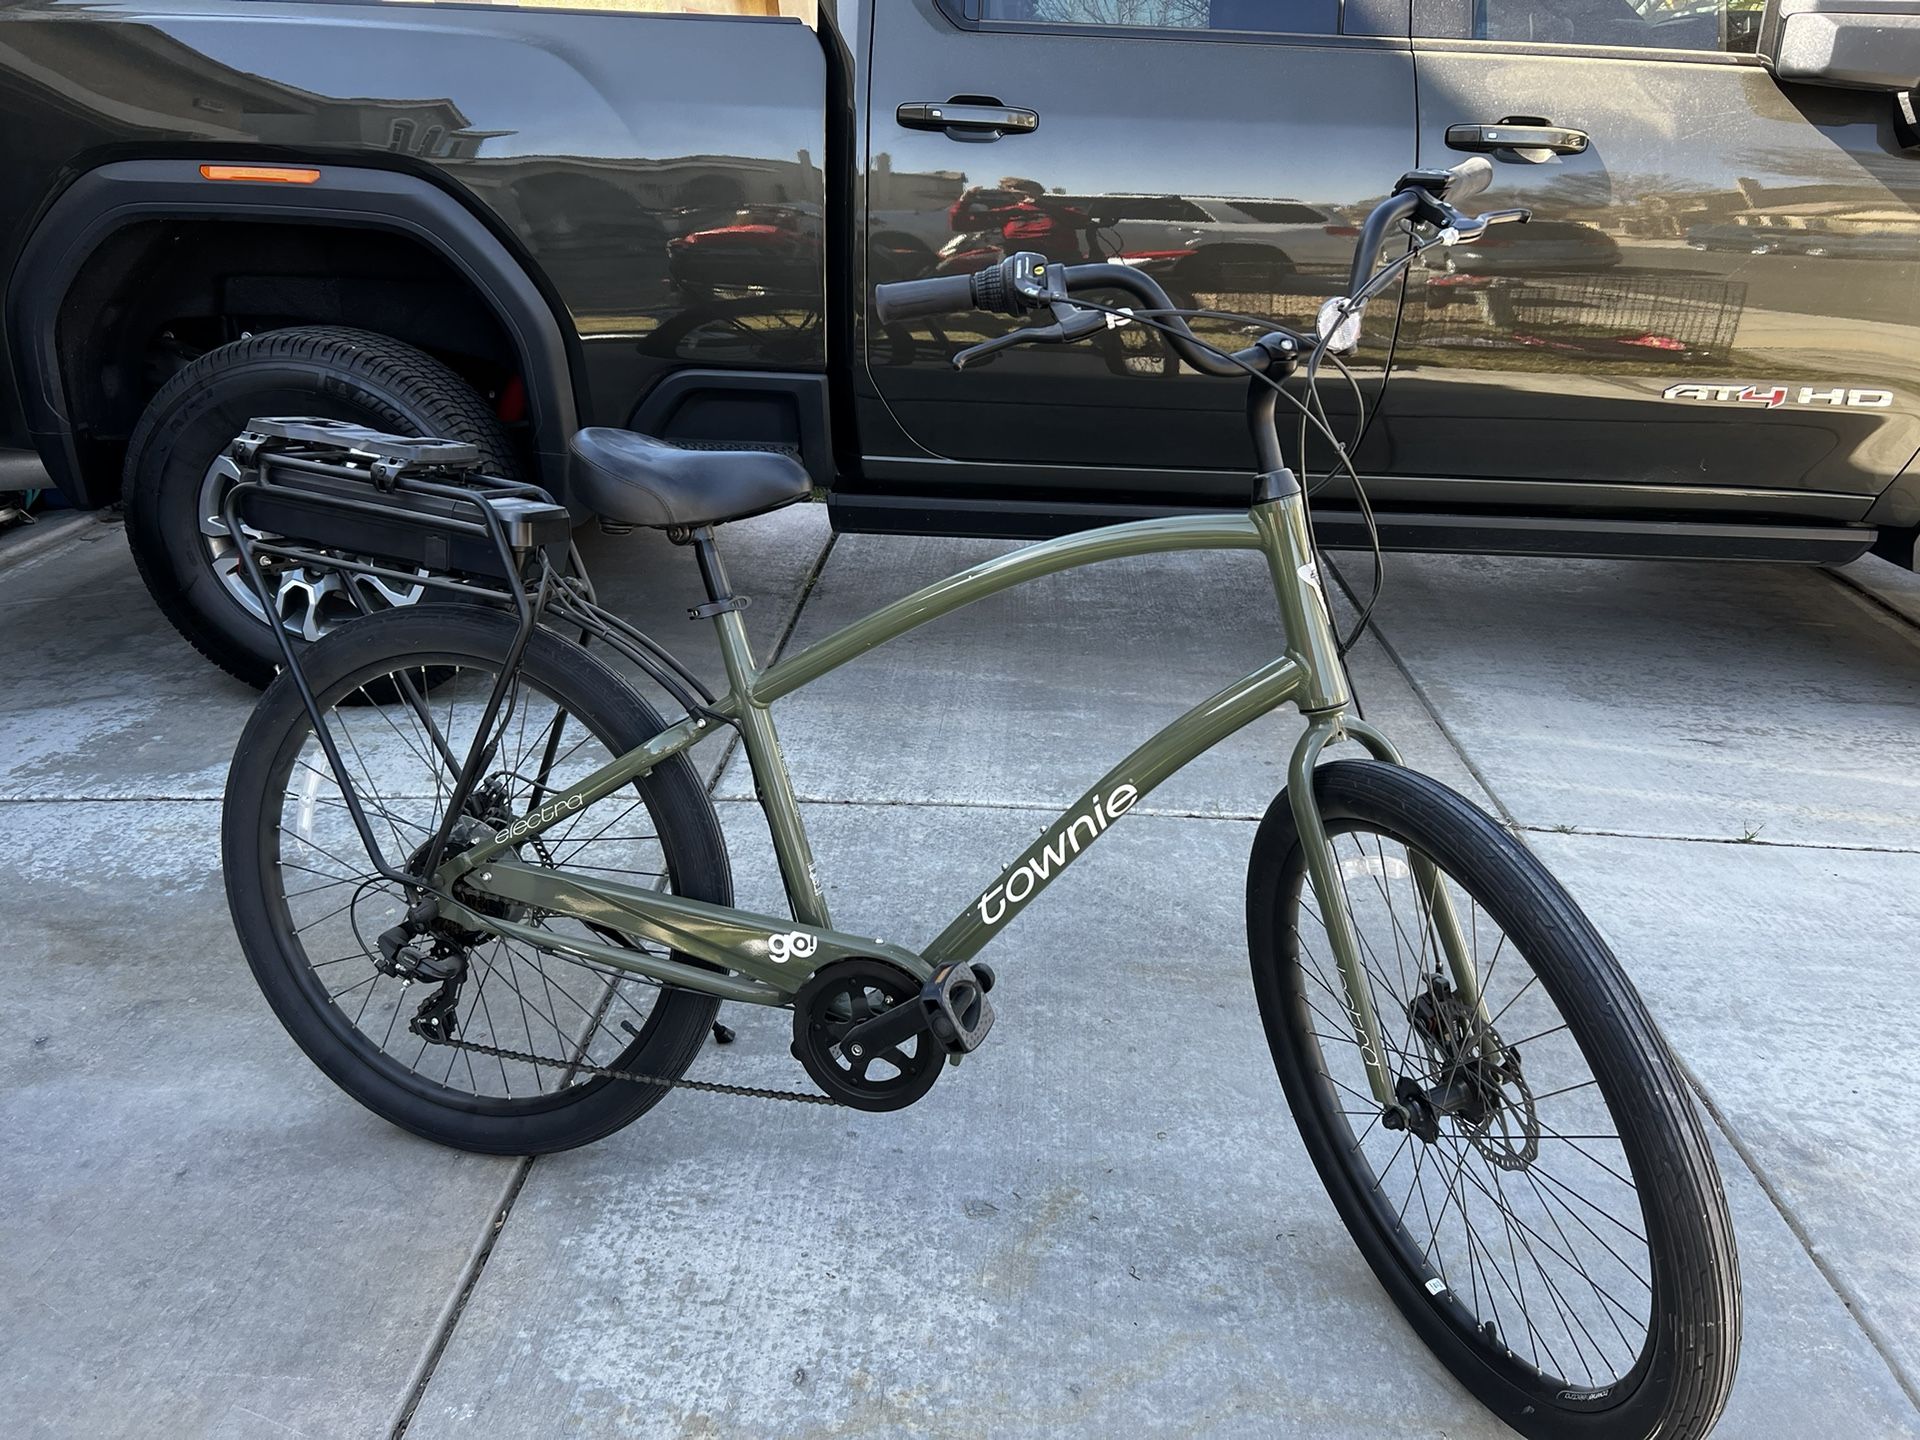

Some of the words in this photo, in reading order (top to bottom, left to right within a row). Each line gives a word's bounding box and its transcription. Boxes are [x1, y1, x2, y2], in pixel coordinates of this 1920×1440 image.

[1662, 383, 1788, 409] AT4
[1798, 387, 1893, 407] HD
[494, 793, 583, 844] electra
[977, 783, 1138, 925] townie
[768, 930, 818, 964] go!
